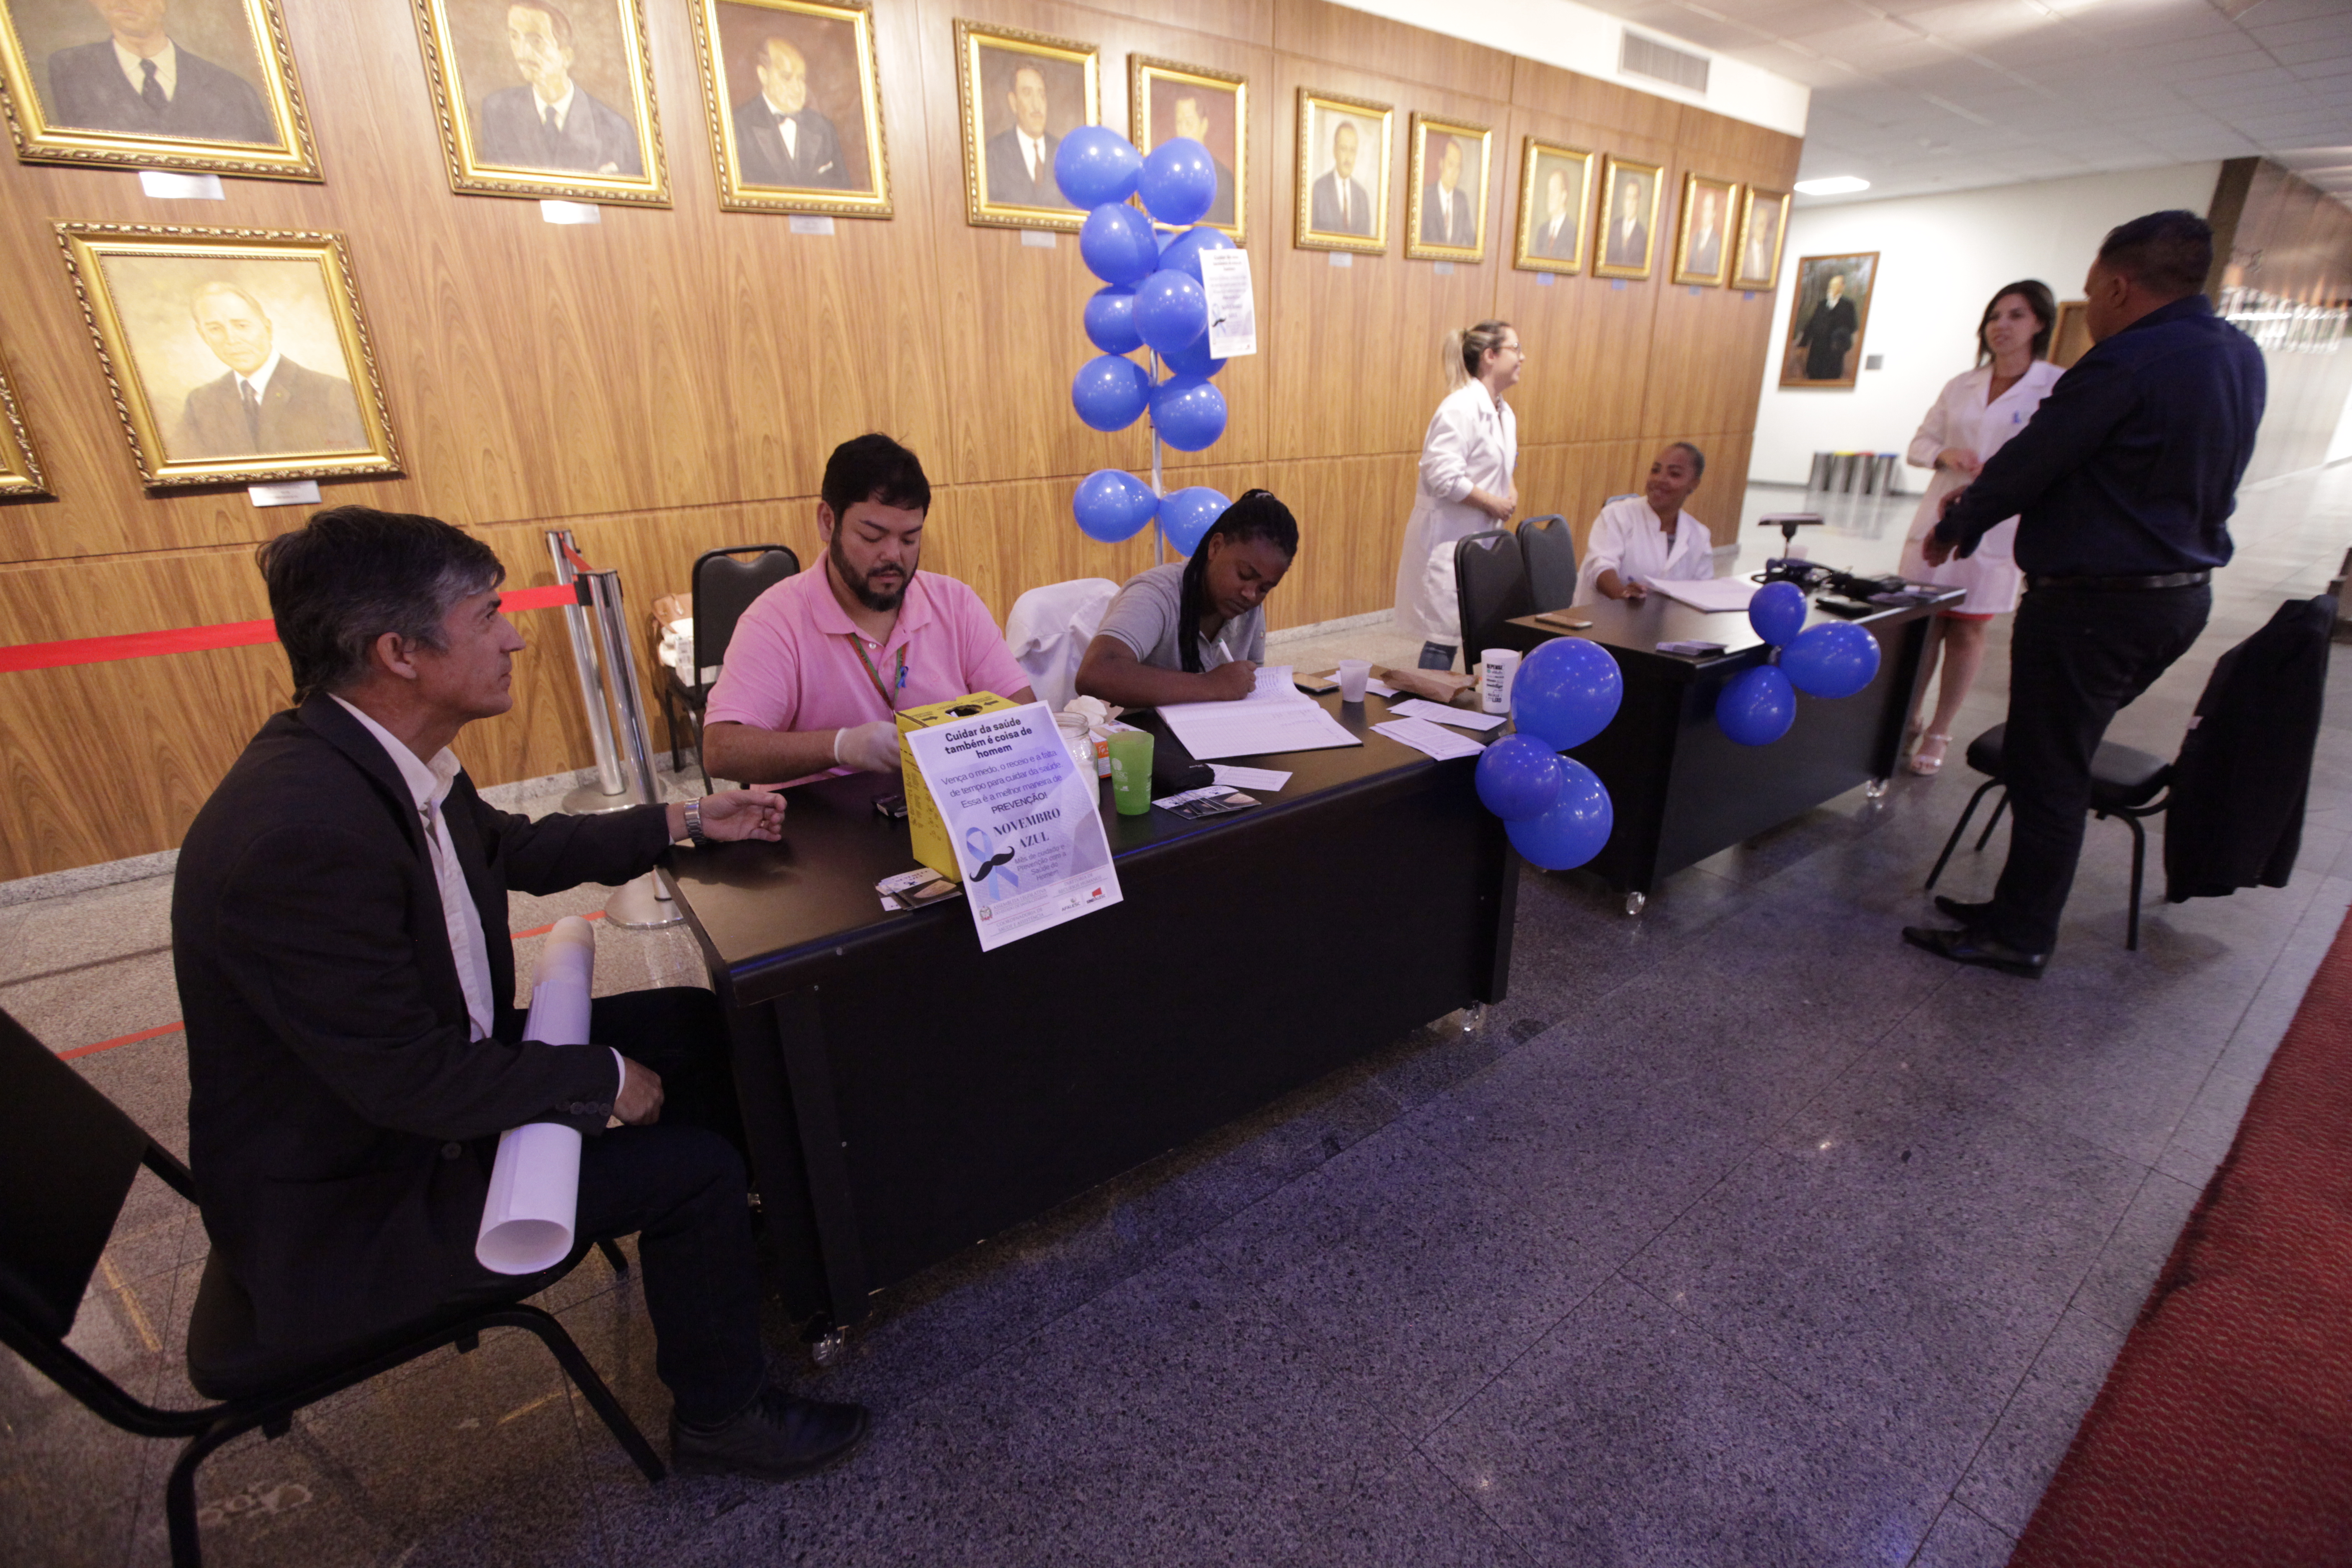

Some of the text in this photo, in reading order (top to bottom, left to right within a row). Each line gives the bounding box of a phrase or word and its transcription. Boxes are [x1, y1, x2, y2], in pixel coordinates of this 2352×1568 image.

[945, 717, 1021, 742] Cuidar da saúde
[945, 727, 1032, 754] também é coisa de
[975, 744, 1012, 758] homem
[941, 774, 967, 786] Vença
[975, 765, 1000, 777] medo,
[1006, 757, 1029, 769] receio
[1041, 749, 1057, 759] falta
[961, 782, 986, 794] tempo
[987, 777, 1005, 789] para
[1005, 771, 1027, 782] cuidar
[1029, 767, 1039, 776] da
[1039, 761, 1063, 773] saúde.
[961, 798, 982, 808] Essa
[996, 786, 1022, 798] melhor
[1022, 778, 1052, 792] maneira
[1052, 774, 1063, 783] de
[991, 791, 1048, 814] PREVENÇÃO!
[993, 808, 1061, 837] NOVEMBRO
[1019, 832, 1050, 849] AZUL
[1014, 856, 1028, 864] Mês
[1037, 846, 1060, 857] cuidado
[1016, 857, 1048, 872] Prevenção
[1031, 864, 1050, 875] Saúde
[1036, 870, 1059, 881] Homem
[1058, 875, 1102, 894] RECURSOS HUMANOS
[1064, 875, 1087, 886] DIRETORIA
[993, 889, 1047, 910] ASSEMBLEIA LEGISLATIVA
[1062, 901, 1081, 911] AFALESC
[996, 910, 1036, 927] COORDENADORIA
